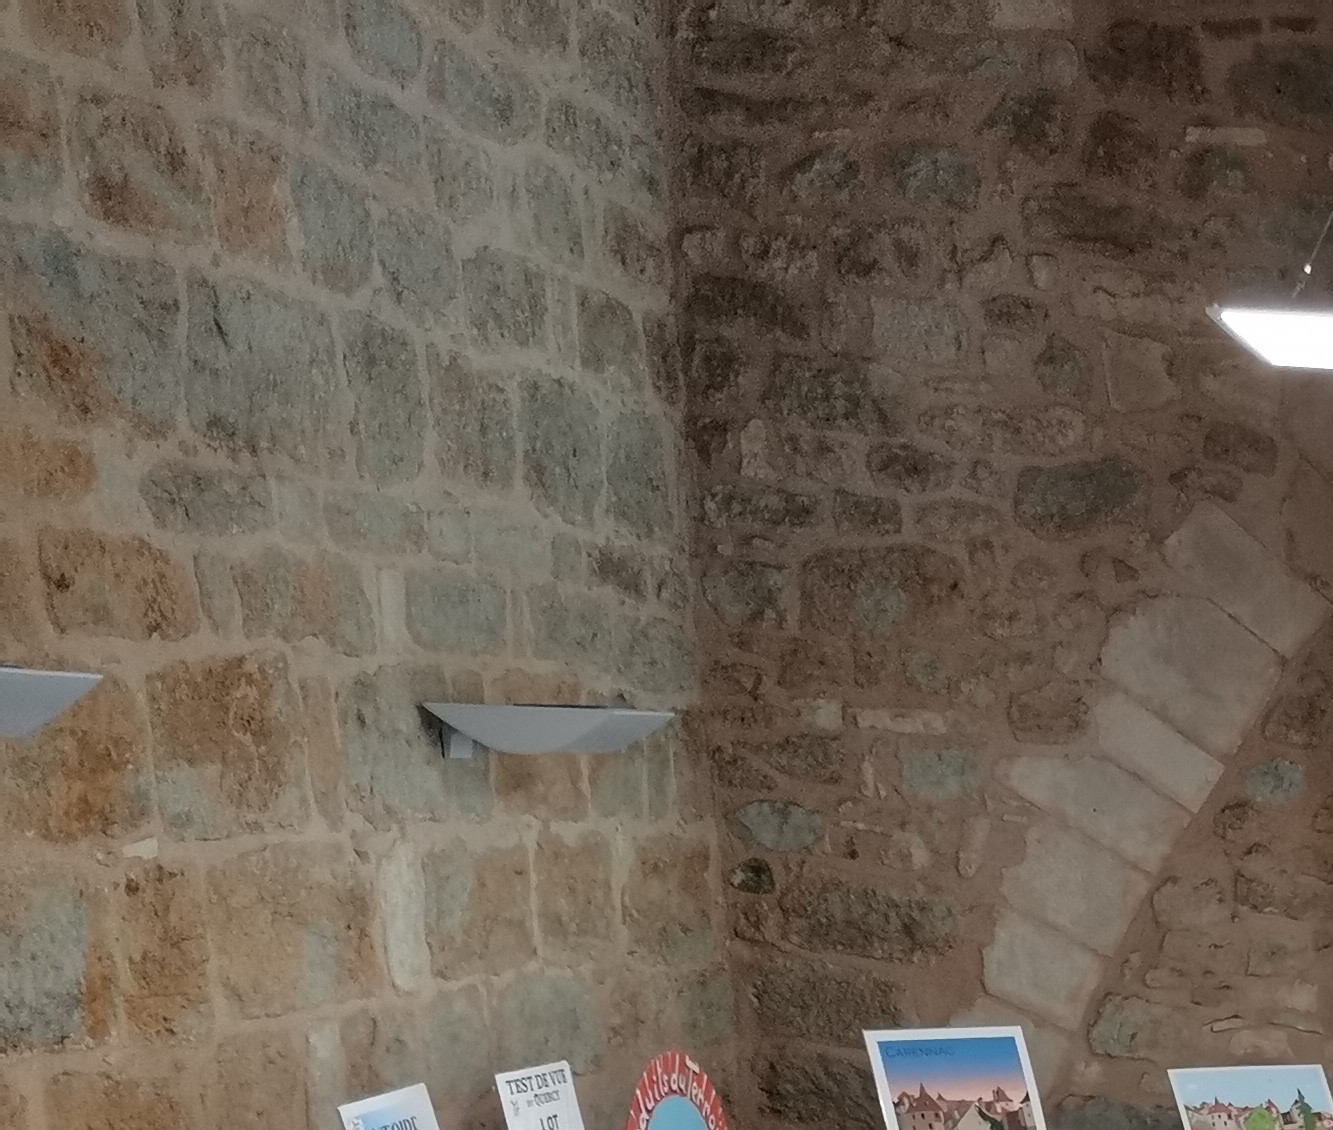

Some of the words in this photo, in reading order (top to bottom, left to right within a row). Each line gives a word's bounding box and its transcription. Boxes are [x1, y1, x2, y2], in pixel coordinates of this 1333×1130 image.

[505, 1076, 535, 1096] TEST
[535, 1073, 549, 1089] DE
[549, 1068, 569, 1086] VUE
